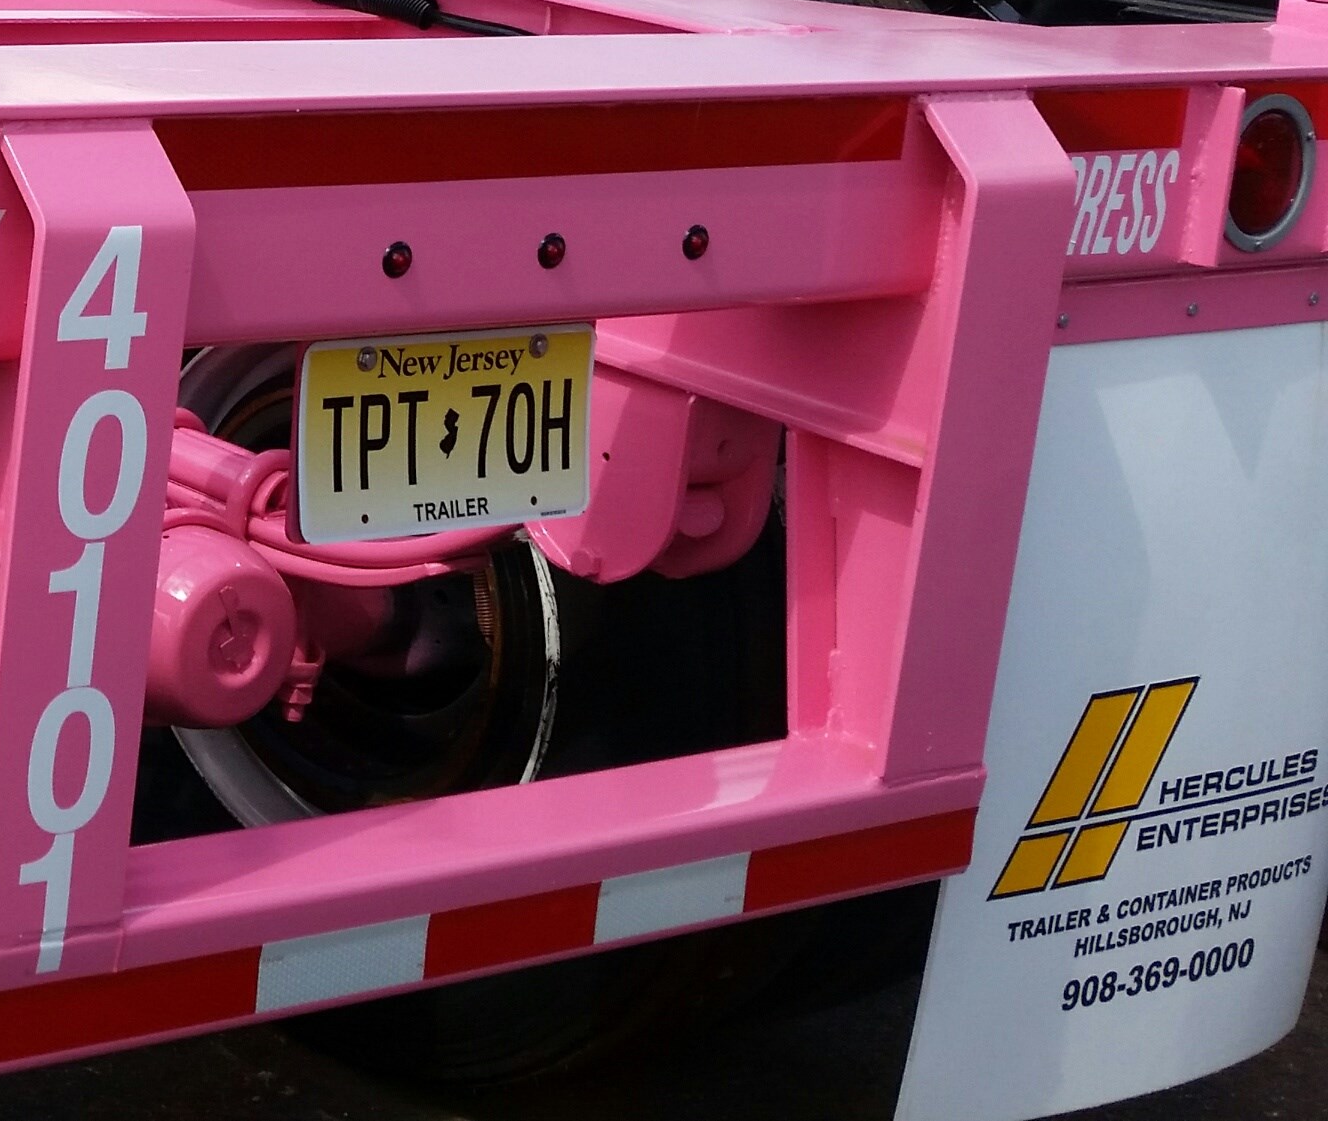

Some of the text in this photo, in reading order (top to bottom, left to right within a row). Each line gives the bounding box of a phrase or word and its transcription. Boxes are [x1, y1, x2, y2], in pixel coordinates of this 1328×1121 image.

[377, 345, 525, 380] New Jersey
[322, 378, 573, 493] TPT 70H
[413, 497, 490, 522] TRAILER
[1158, 748, 1319, 805] HERCULES
[1008, 854, 1313, 942] TRAILER & CONTAINER PRODUCTS
[1073, 899, 1252, 958] HILLSBOROUGH, NJ
[1061, 937, 1255, 1011] 908-369-0000
